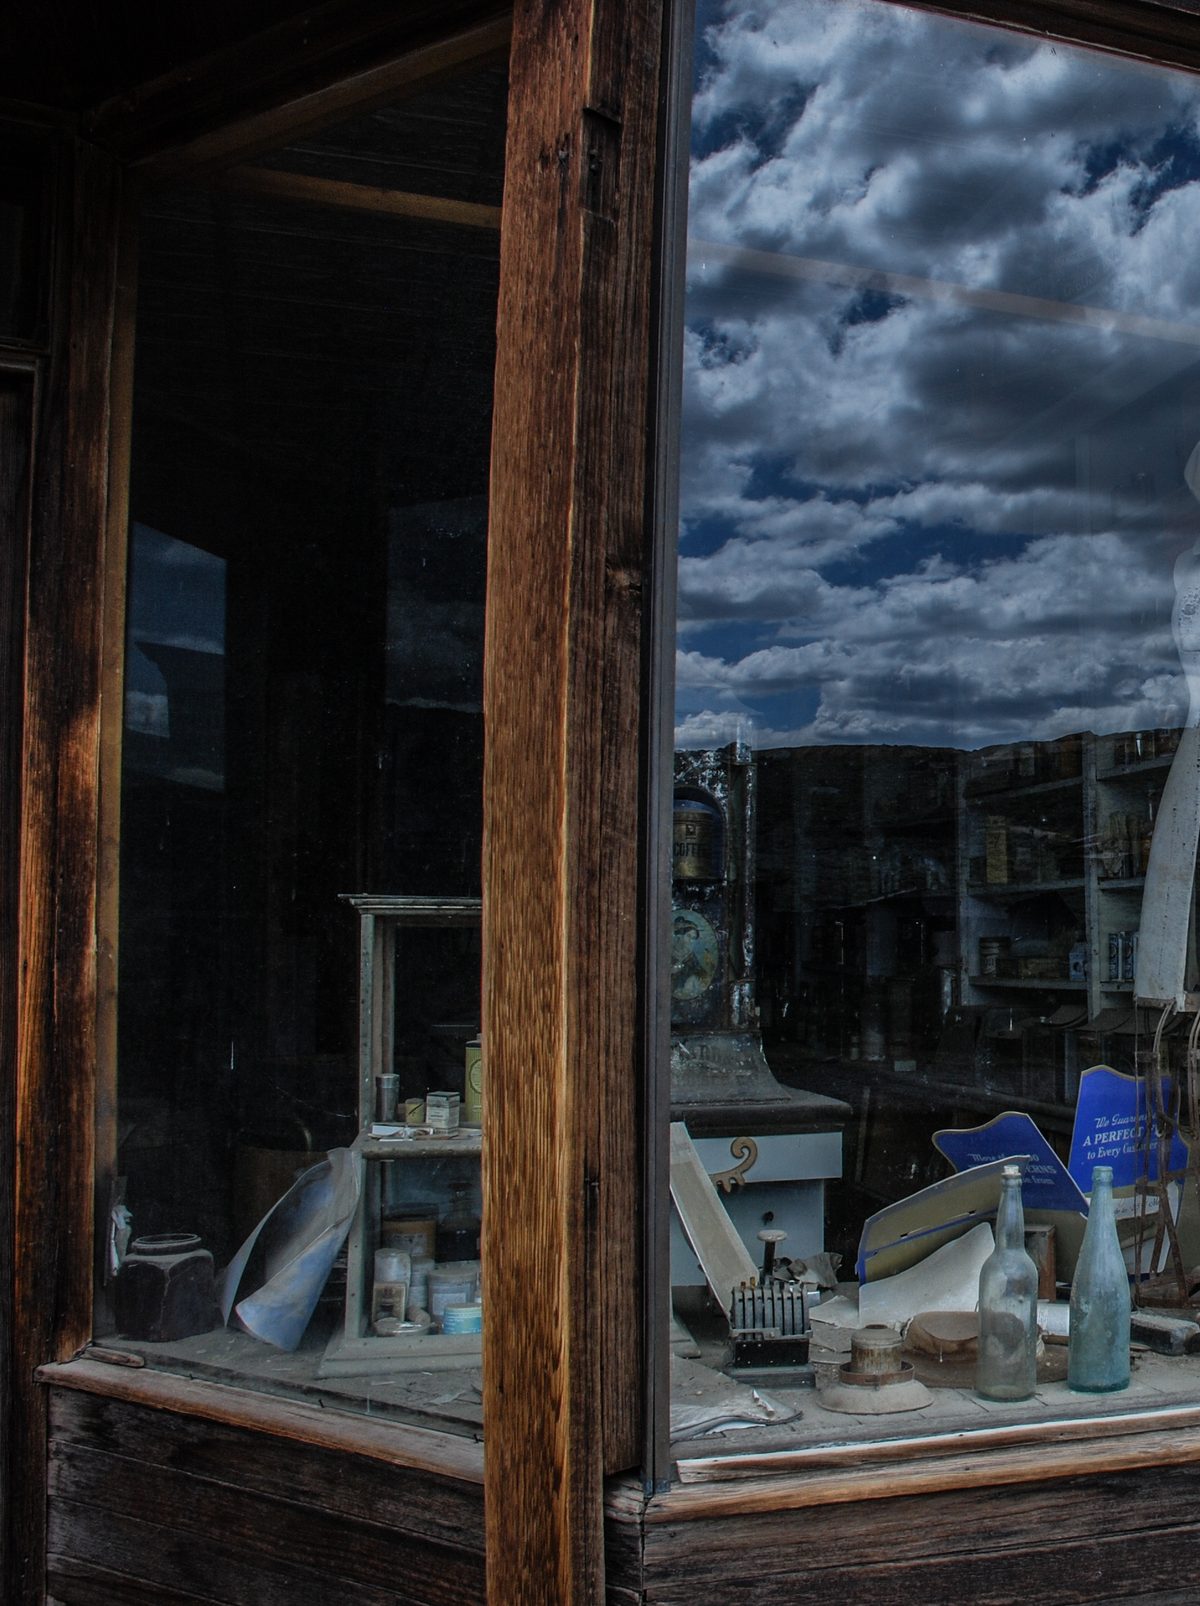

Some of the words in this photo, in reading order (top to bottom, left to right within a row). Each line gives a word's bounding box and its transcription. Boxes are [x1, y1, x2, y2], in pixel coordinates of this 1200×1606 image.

[1083, 1135, 1091, 1147] A
[1094, 1126, 1144, 1144] PERFECT
[1087, 1151, 1096, 1160] to
[1097, 1146, 1120, 1158] Every
